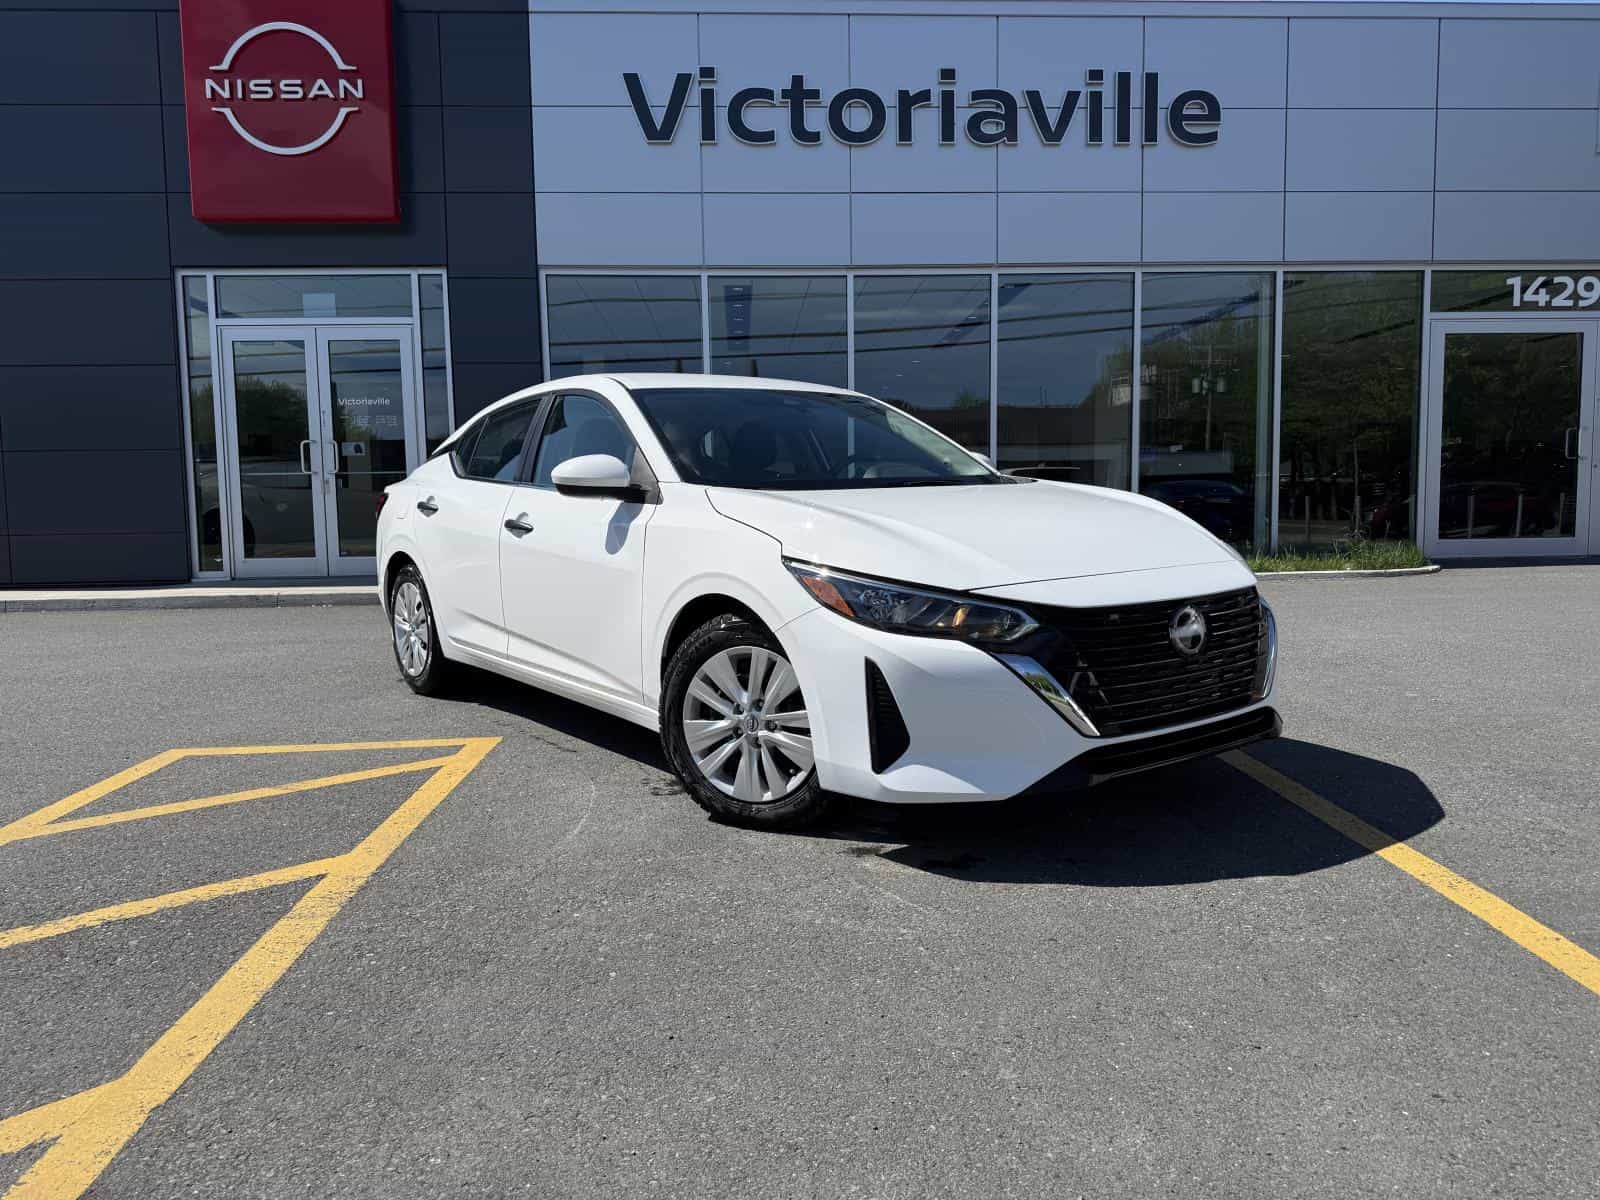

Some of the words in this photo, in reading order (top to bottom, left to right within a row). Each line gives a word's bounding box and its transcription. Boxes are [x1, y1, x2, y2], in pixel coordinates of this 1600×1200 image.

[204, 78, 364, 99] NISSAN
[622, 65, 1222, 146] Victoriaville
[1505, 275, 1600, 307] 1429
[337, 397, 391, 406] Victoriaville
